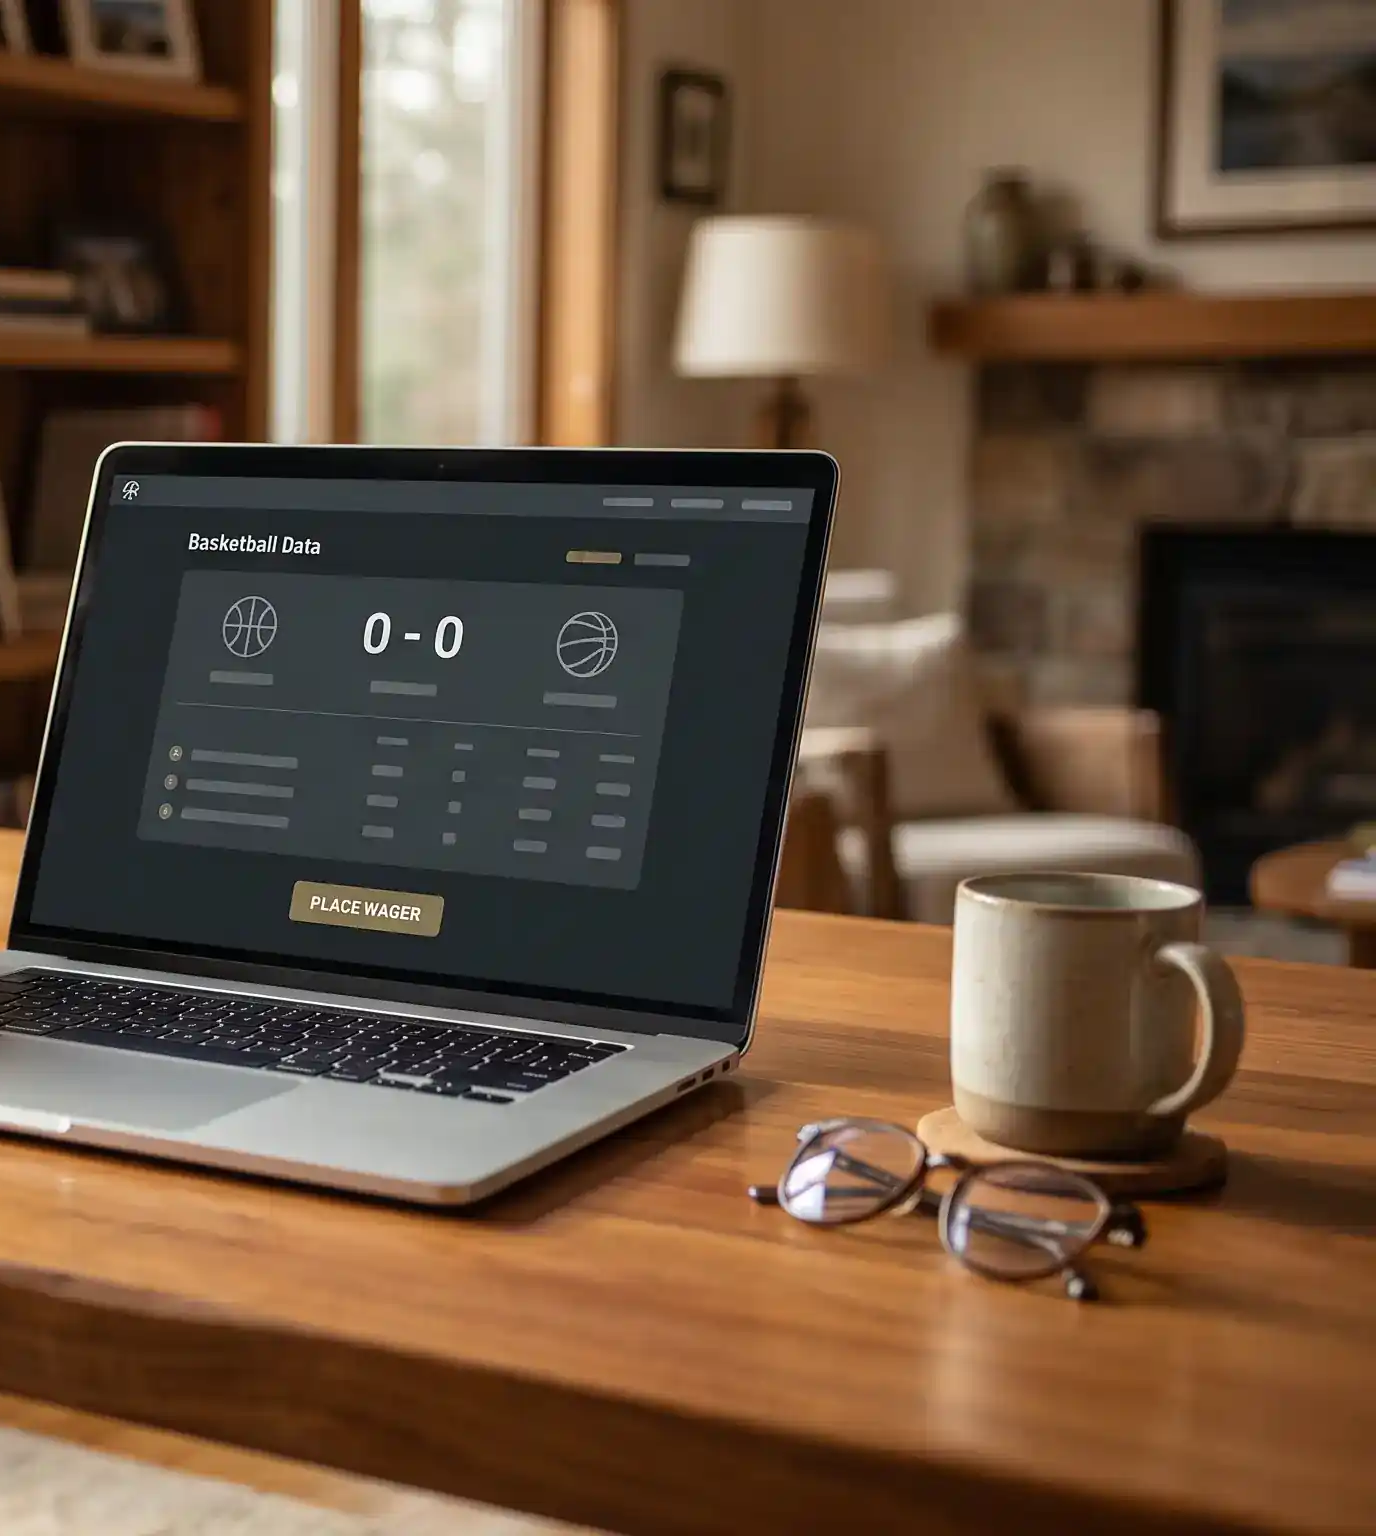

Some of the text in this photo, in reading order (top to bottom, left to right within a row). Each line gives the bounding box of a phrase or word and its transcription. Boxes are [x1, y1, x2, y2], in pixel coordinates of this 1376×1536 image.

[189, 533, 320, 554] Basketball Data
[364, 612, 391, 654] 0
[435, 616, 463, 658] 0
[310, 896, 420, 921] PLACE WAGER
